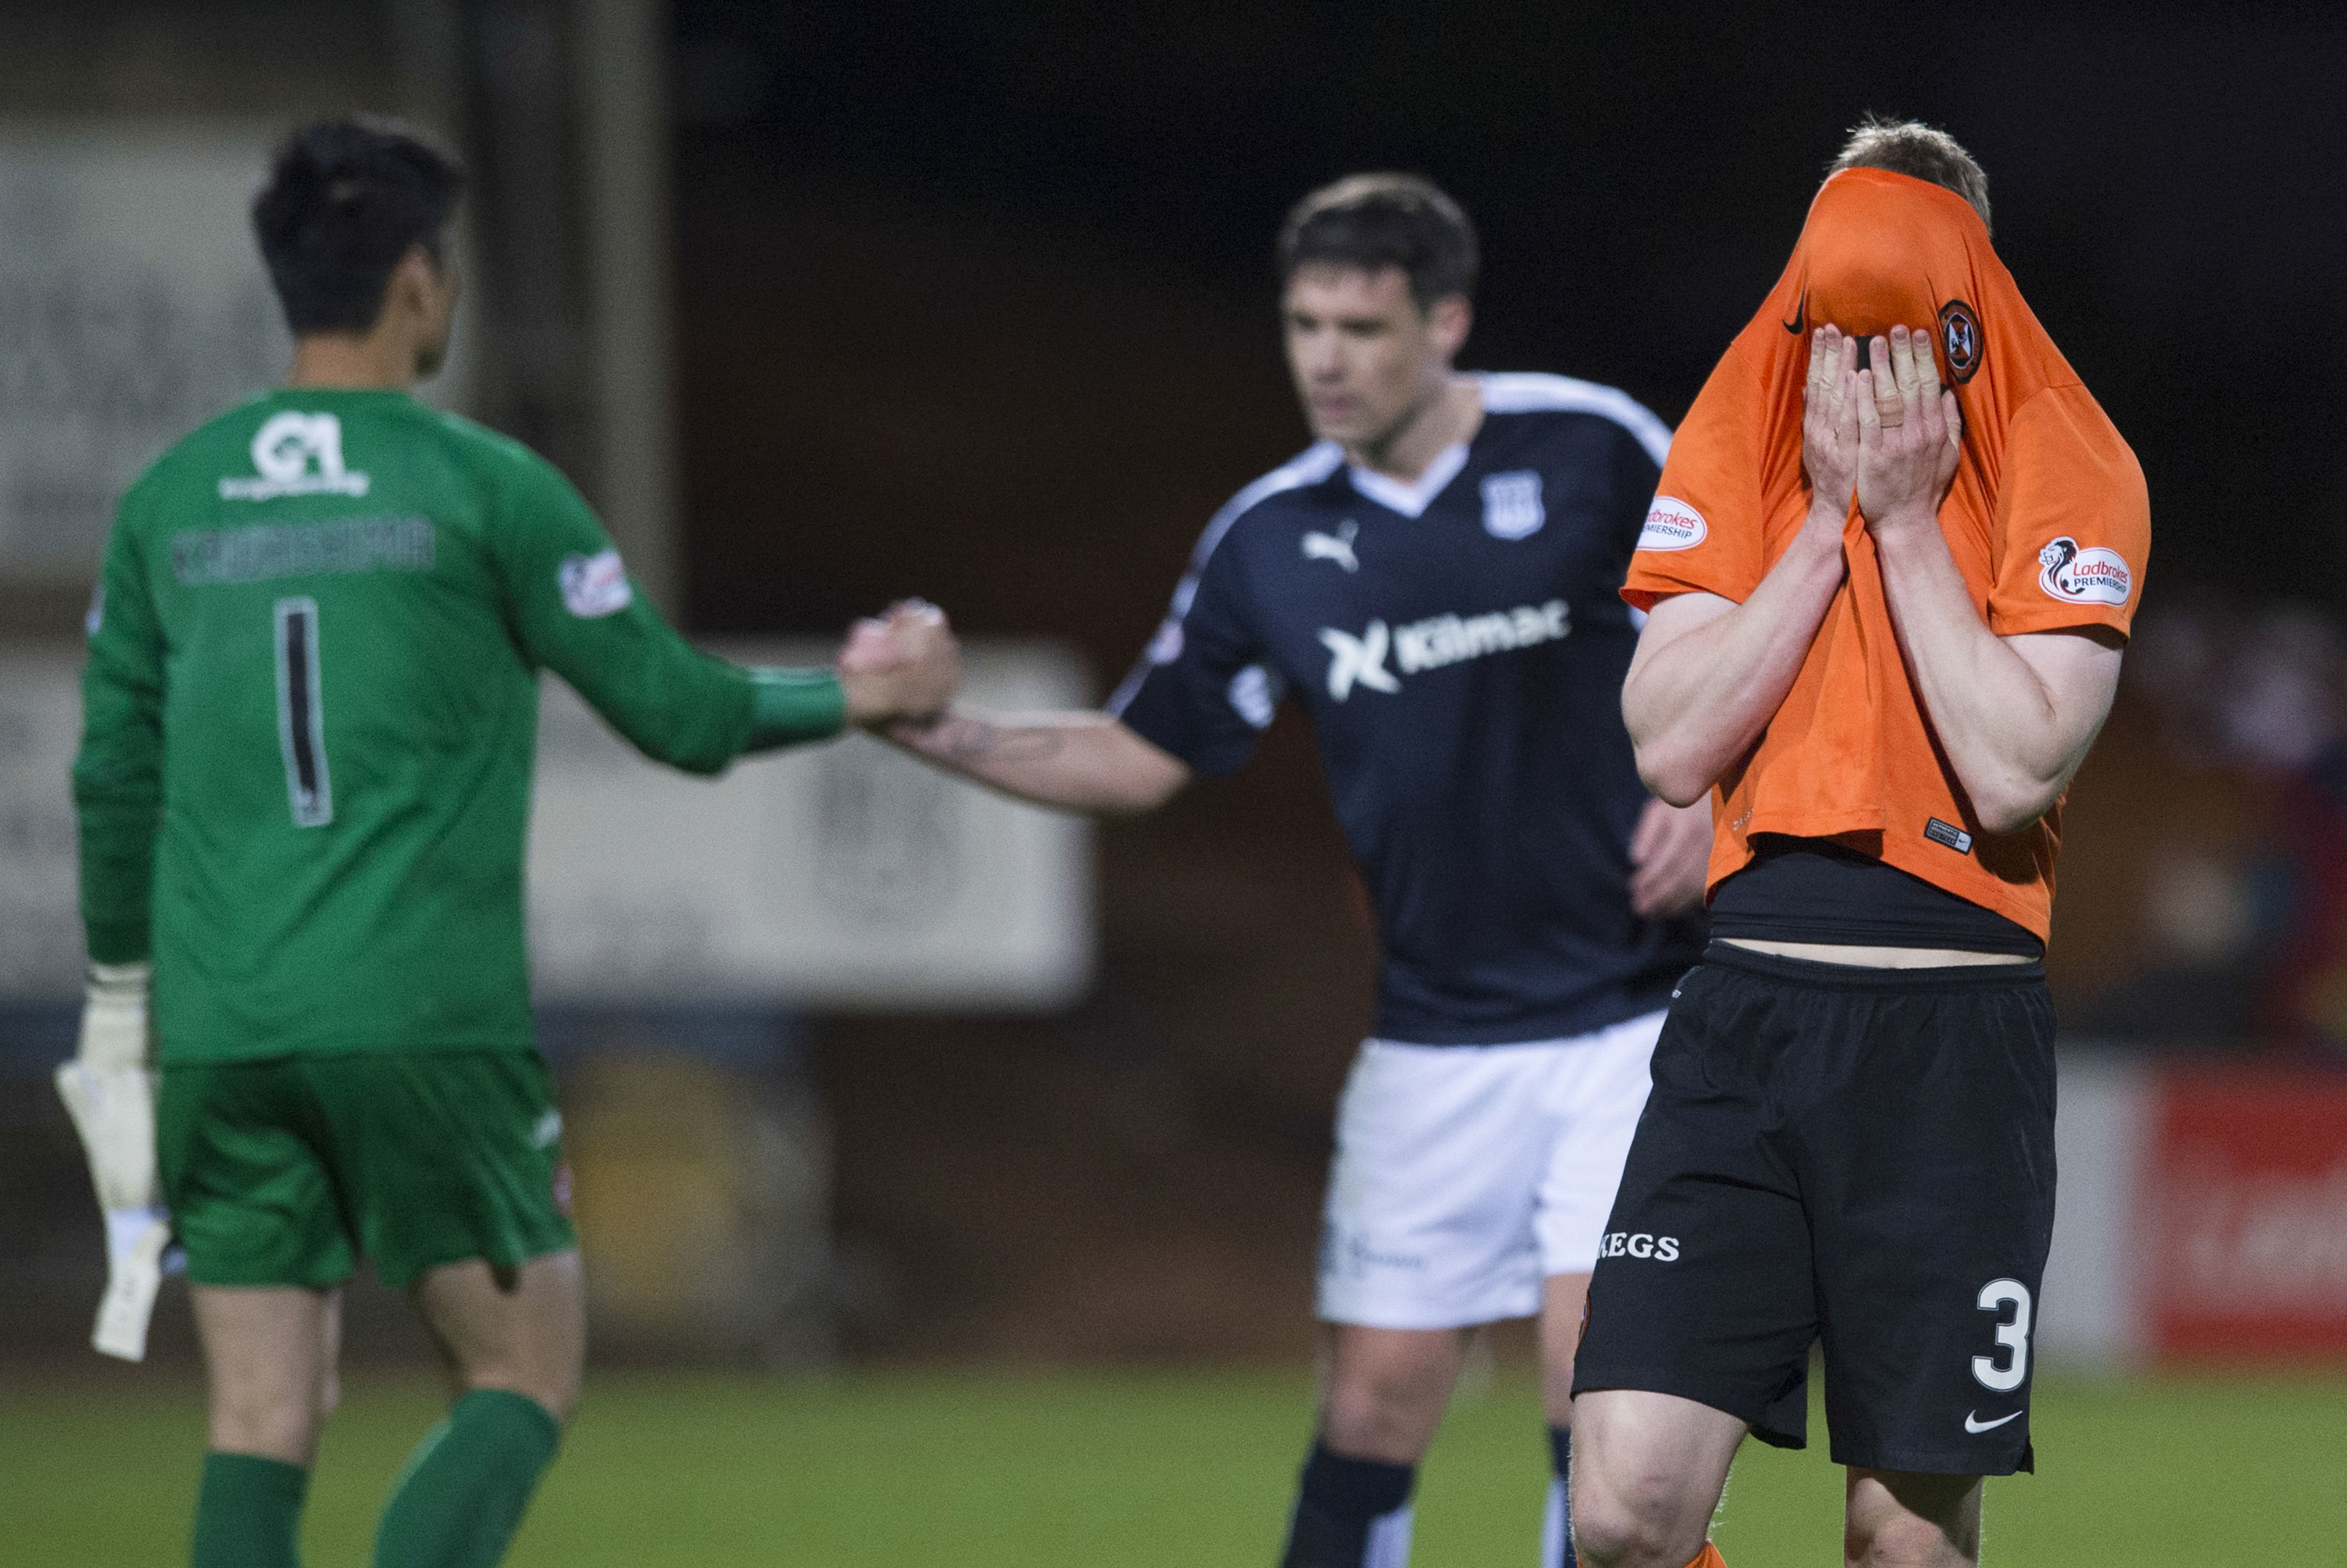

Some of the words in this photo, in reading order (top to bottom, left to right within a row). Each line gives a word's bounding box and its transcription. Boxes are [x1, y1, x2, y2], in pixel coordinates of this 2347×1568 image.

[2073, 561, 2128, 584] Ladbrokes
[2074, 577, 2127, 594] PREMIERSHIP
[1395, 598, 1571, 675] Kilmac
[273, 595, 333, 828] 1
[1972, 1278, 2031, 1392] 3
